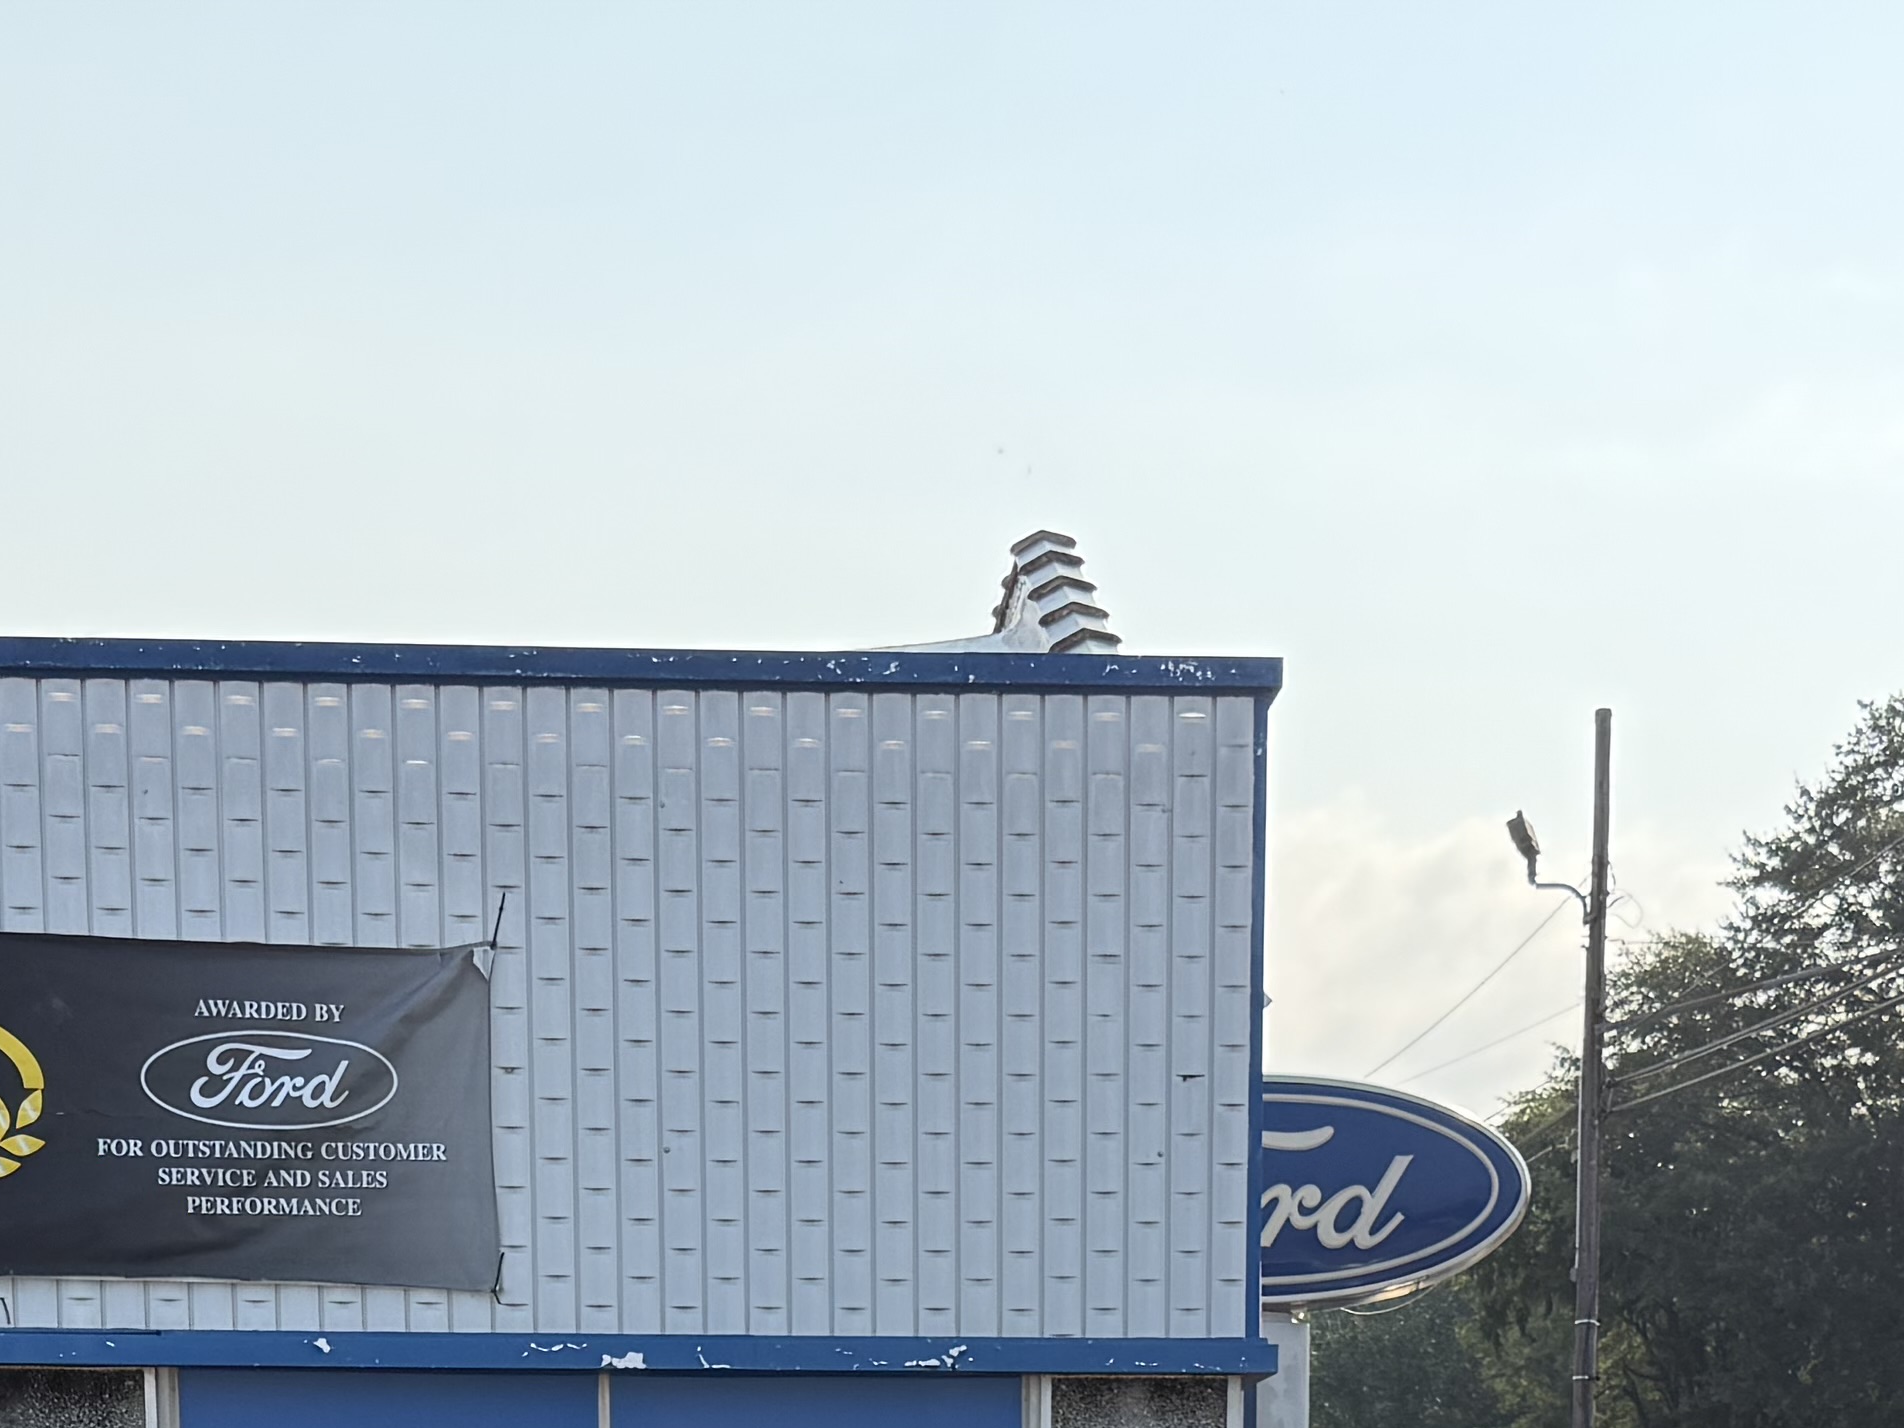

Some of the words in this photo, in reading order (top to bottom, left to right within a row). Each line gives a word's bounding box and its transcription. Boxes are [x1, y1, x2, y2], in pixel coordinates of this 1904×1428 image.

[194, 999, 307, 1021] AWARDED
[314, 1003, 345, 1022] BY
[189, 1042, 349, 1109] Ford
[97, 1138, 144, 1157] FOR
[150, 1139, 313, 1160] OUTSTANDING
[320, 1142, 447, 1162] CUSTOMER
[157, 1167, 257, 1187] SERVICE
[264, 1170, 311, 1188] AND
[318, 1170, 388, 1189] SALES
[1260, 1125, 1415, 1250] rd
[187, 1196, 363, 1217] PERFORMANCE
